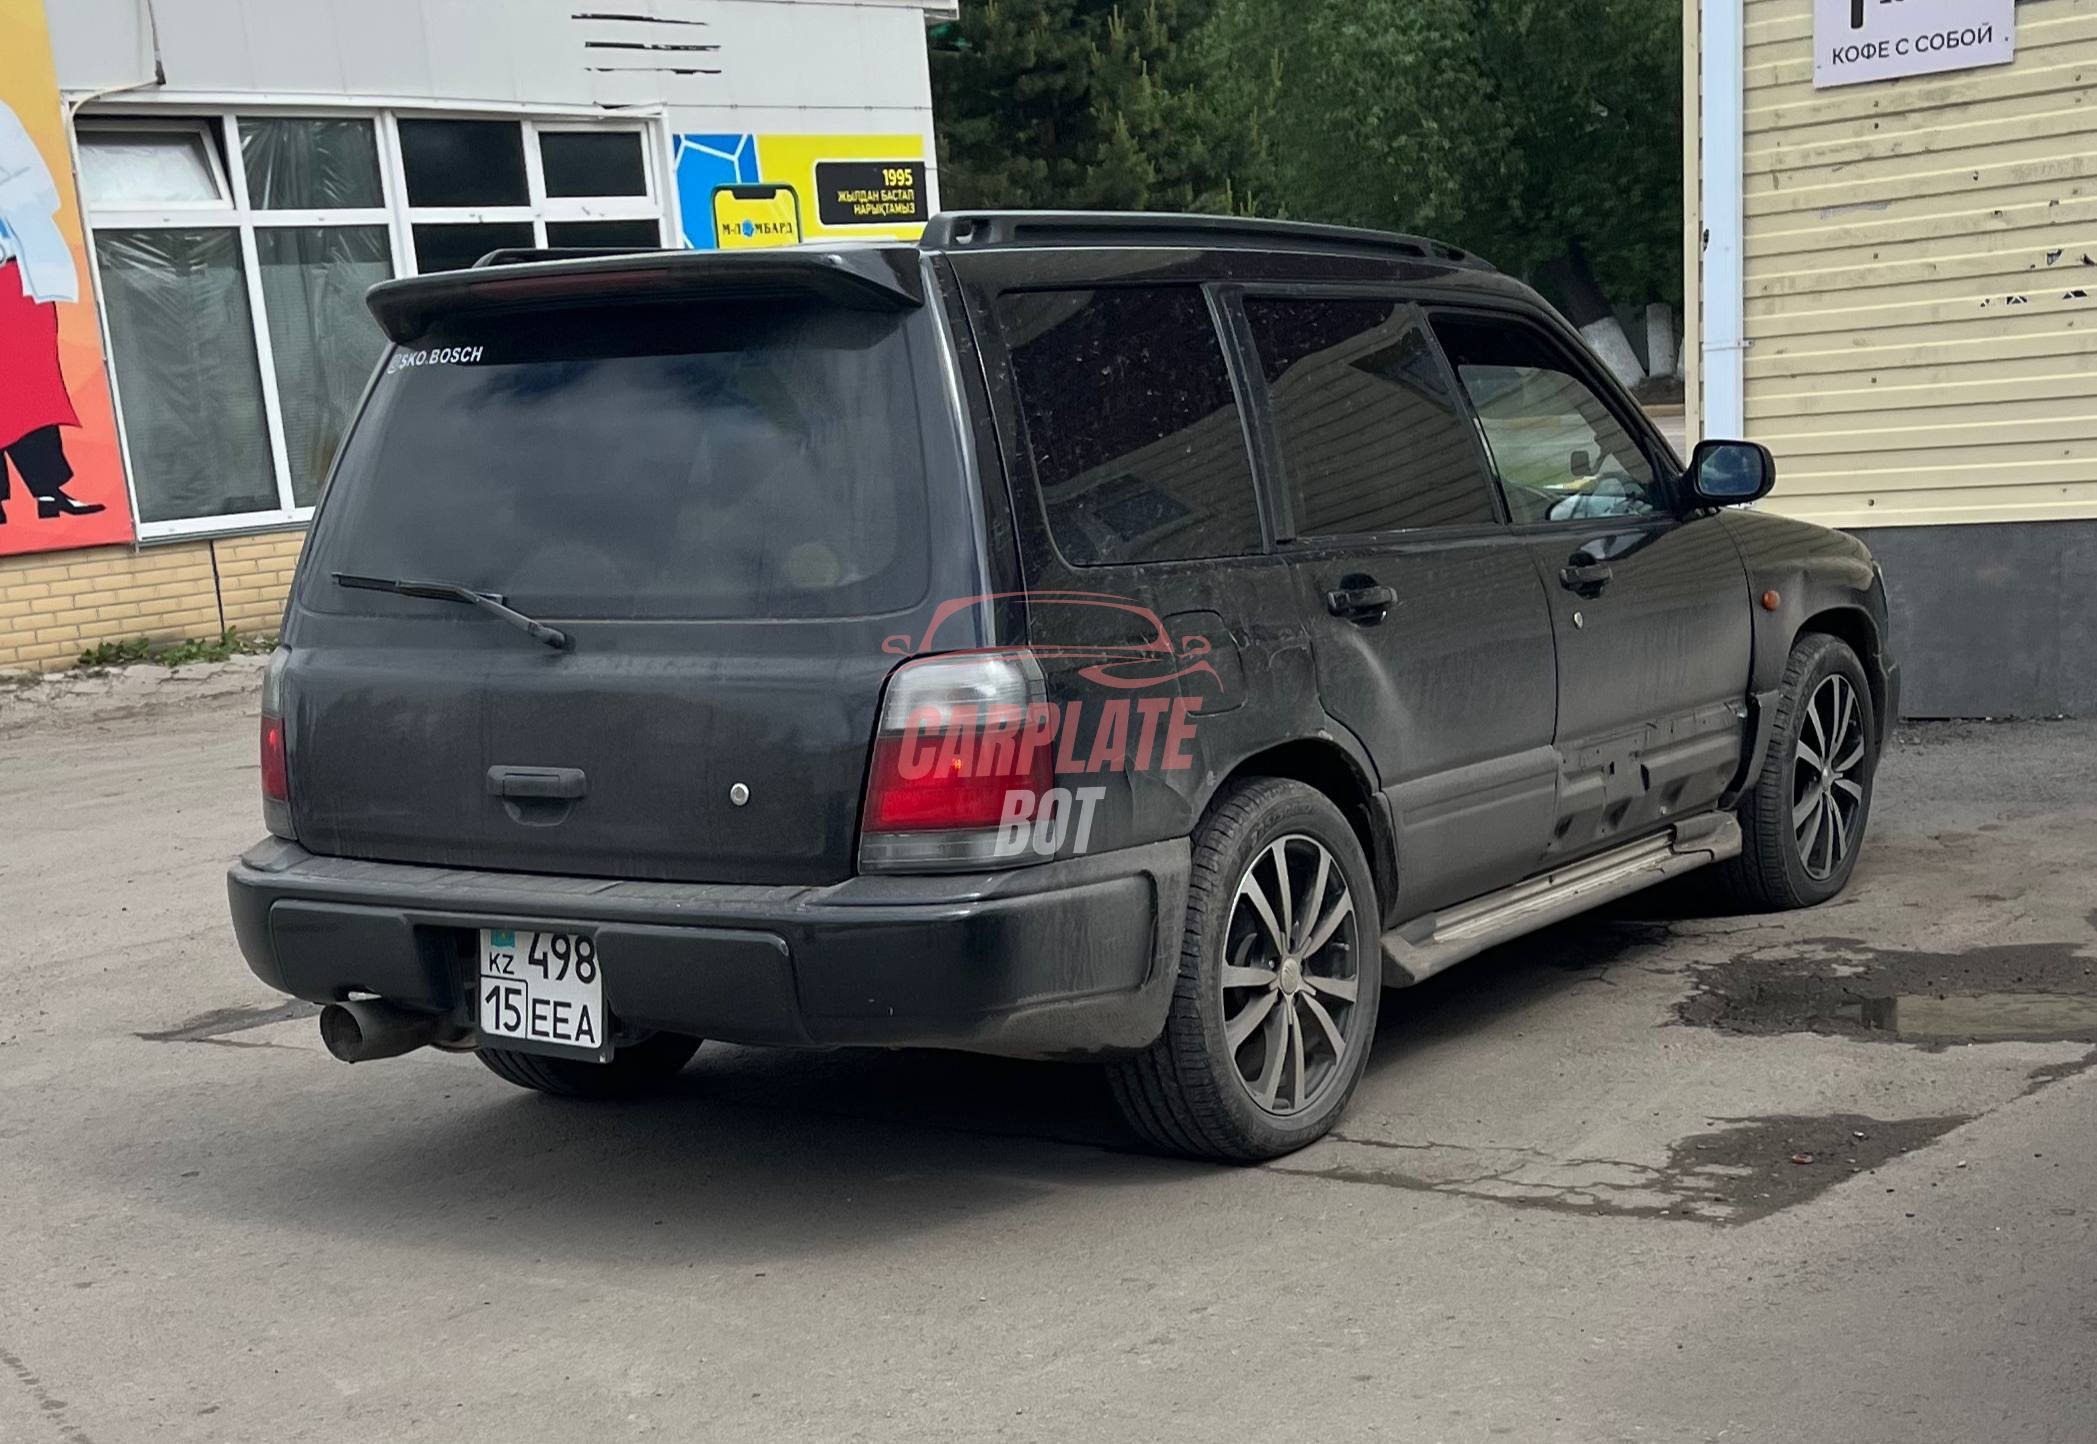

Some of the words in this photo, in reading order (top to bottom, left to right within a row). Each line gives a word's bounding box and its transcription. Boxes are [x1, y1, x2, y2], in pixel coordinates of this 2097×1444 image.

[1832, 40, 1890, 65] КОФЕ
[1895, 38, 1910, 56] С
[1914, 22, 1994, 53] СОБОЙ
[882, 168, 913, 186] 1995
[837, 190, 879, 203] ЖЫЛДАН
[881, 189, 915, 201] БАСТАП
[853, 203, 916, 217] НАРЫҚТАМЫЗ
[489, 952, 515, 975] KZ
[528, 932, 597, 984] 498
[485, 985, 522, 1032] 15
[531, 998, 596, 1043] EEA
